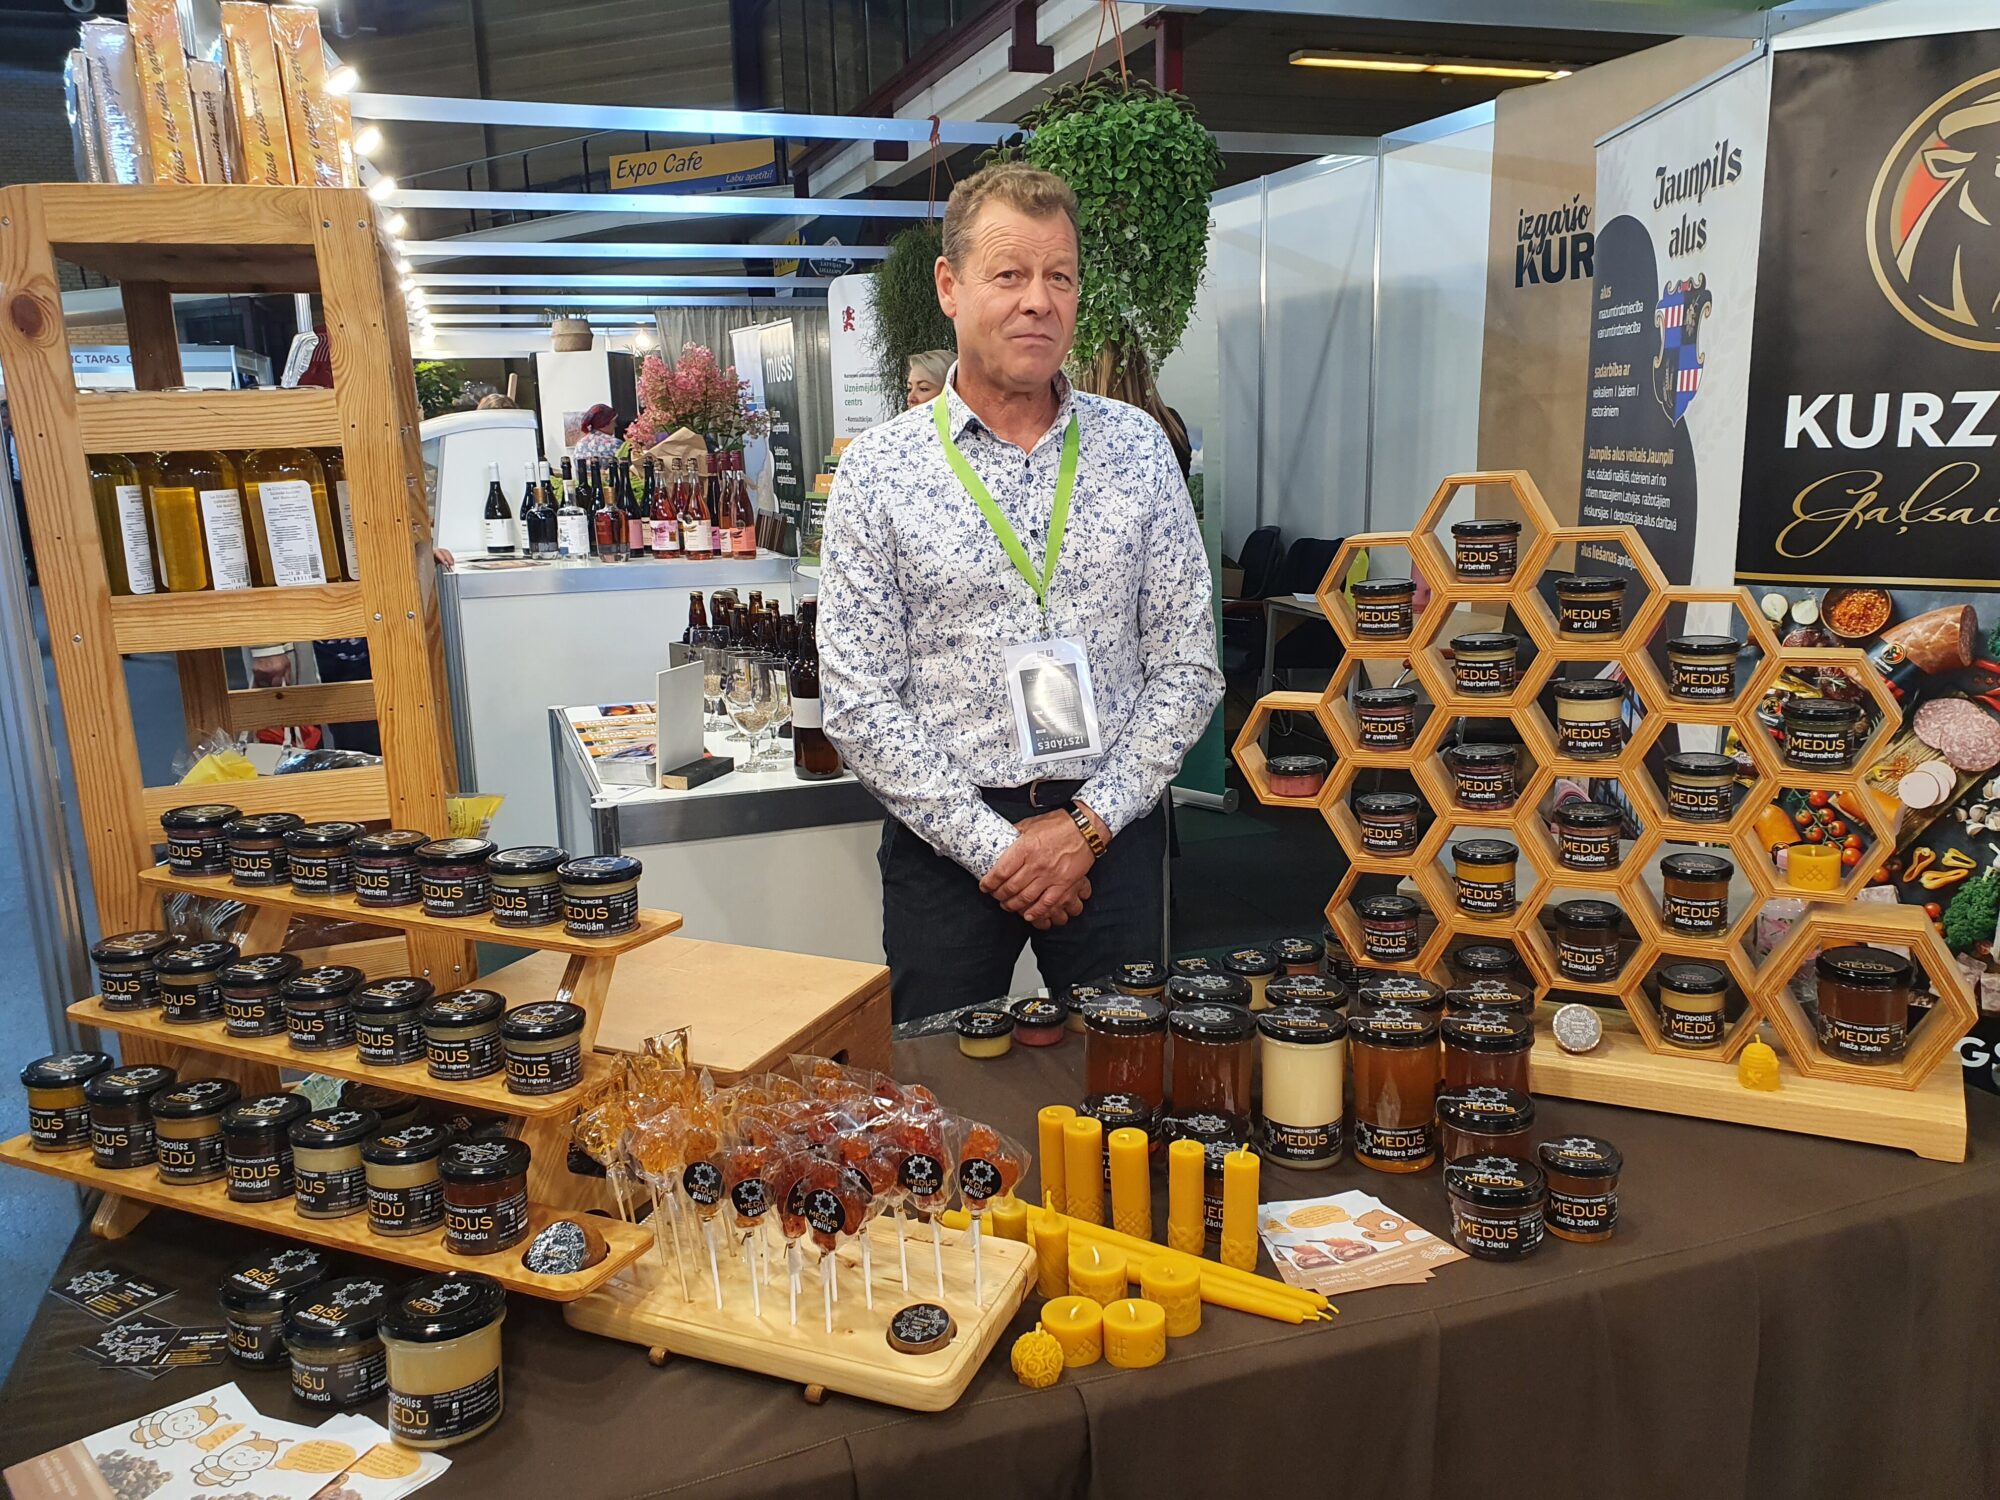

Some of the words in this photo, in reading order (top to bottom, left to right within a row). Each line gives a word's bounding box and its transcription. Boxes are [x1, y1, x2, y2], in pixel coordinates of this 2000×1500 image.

[617, 160, 657, 183] Expo
[664, 151, 703, 173] Cafe
[726, 174, 743, 183] Labu
[1652, 139, 1743, 210] Jaunpils
[1517, 193, 1592, 254] izgaršo
[1668, 213, 1708, 260] alus
[1600, 285, 1612, 299] alus
[84, 355, 120, 364] TAPAS
[765, 353, 793, 384] muss
[1594, 363, 1622, 379] sadarbība
[1784, 391, 2000, 449] KURZ
[1588, 446, 1612, 462] Jaunpils
[1612, 448, 1626, 460] alus
[1626, 447, 1646, 463] veikals
[1643, 515, 1655, 526] alus
[1456, 551, 1498, 562] MEDUS
[1357, 610, 1400, 622] MEDUS
[1562, 609, 1611, 620] MEDUS
[1583, 620, 1597, 629] čili
[1456, 668, 1499, 680] MEDUS
[1679, 673, 1730, 685] MEDUS
[1460, 679, 1500, 688] rabarberiem
[1361, 722, 1406, 733] MEDUS
[1562, 727, 1611, 739] MEDUS
[1372, 732, 1398, 740] avenēm
[1038, 735, 1084, 751] IZSTĀDES
[1576, 739, 1603, 748] ingveru
[1791, 737, 1845, 751] MEDUS
[1457, 779, 1502, 791] MEDUS
[1469, 791, 1496, 800] upenēm
[1670, 791, 1718, 805] MEDUS
[1361, 827, 1403, 839] MEDUS
[1369, 837, 1398, 847] zemenēm
[1562, 839, 1610, 853] MEDUS
[232, 857, 272, 869] EDUS
[291, 866, 328, 878] EDUS
[422, 887, 464, 899] EDUS
[1457, 887, 1503, 900] MEDUS
[565, 907, 609, 920] EDUS
[1670, 905, 1720, 918] MEDUS
[1675, 917, 1692, 926] meža
[1365, 933, 1407, 946] MEDUS
[1560, 949, 1605, 964] MEDUS
[100, 980, 141, 992] EDUS
[168, 1005, 180, 1016] čili
[226, 1005, 265, 1018] EDUS
[1675, 1013, 1712, 1022] propoliss
[286, 1019, 325, 1032] EDUS
[1671, 1020, 1716, 1034] MEDŪ
[356, 1033, 394, 1047] EDUS
[1834, 1027, 1891, 1044] MEDUS
[1839, 1041, 1861, 1051] meža
[1862, 1042, 1882, 1052] ziedu
[428, 1049, 470, 1062] EDUS
[448, 1062, 471, 1070] ingveru
[505, 1063, 550, 1077] EDUS
[527, 1076, 551, 1086] ingveru
[1458, 1103, 1516, 1114] MEDUS
[308, 1118, 341, 1132] MEDUS
[92, 1133, 129, 1146] EDUS
[1277, 1132, 1328, 1146] MEDUS
[1373, 1134, 1425, 1148] MEDUS
[1286, 1147, 1315, 1156] krēmots
[1372, 1147, 1406, 1158] pavasara
[1406, 1147, 1426, 1157] ziedu
[234, 1179, 270, 1189] šokolādi
[906, 1178, 938, 1188] MEDUS
[961, 1177, 992, 1194] MEDUS
[1464, 1175, 1525, 1187] MEDUS
[688, 1182, 719, 1198] MEDUS
[368, 1202, 405, 1217] EDŪ
[1551, 1201, 1608, 1217] MEDUS
[446, 1216, 494, 1230] EDUS
[808, 1209, 838, 1228] MEDUS
[1461, 1212, 1478, 1221] FOREST
[1556, 1215, 1576, 1226] meža
[1577, 1217, 1600, 1228] ziedu
[463, 1230, 489, 1242] ziedu
[1460, 1220, 1519, 1239] MEDUS
[1466, 1236, 1485, 1247] meža
[1486, 1239, 1509, 1249] ziedu
[244, 1268, 280, 1285] BIŠU
[308, 1304, 348, 1321] BIŠU
[408, 1299, 441, 1313] MEDŪ
[227, 1329, 258, 1349] BIŠU
[292, 1368, 325, 1391] BIŠU
[306, 1390, 331, 1402] medū
[391, 1404, 429, 1426] EDŪ
[408, 1427, 427, 1435] HONEY
